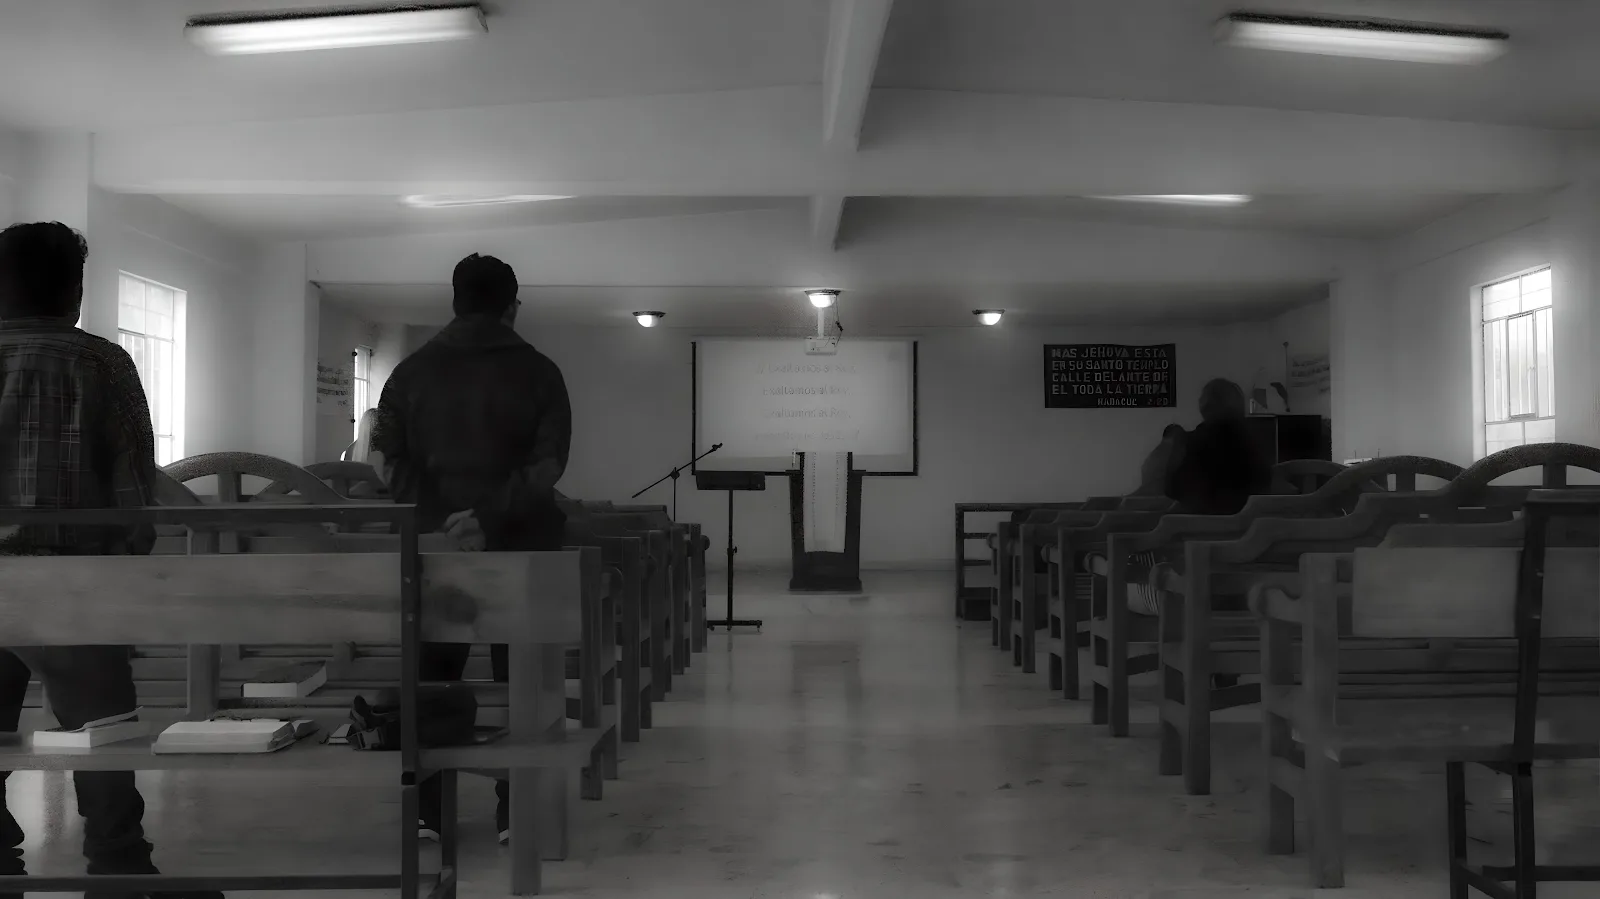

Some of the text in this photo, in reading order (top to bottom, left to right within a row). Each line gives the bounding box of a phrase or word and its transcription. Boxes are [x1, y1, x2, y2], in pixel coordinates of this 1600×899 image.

[1081, 346, 1130, 358] JEHOVA
[1134, 348, 1167, 358] ESTA
[1069, 360, 1084, 371] SU
[1085, 359, 1124, 371] SANTO
[1052, 372, 1091, 382] CALLE
[1094, 371, 1150, 382] DELANTE
[1052, 384, 1068, 395] EL
[1072, 384, 1103, 395] TODA
[1106, 383, 1123, 394] LA
